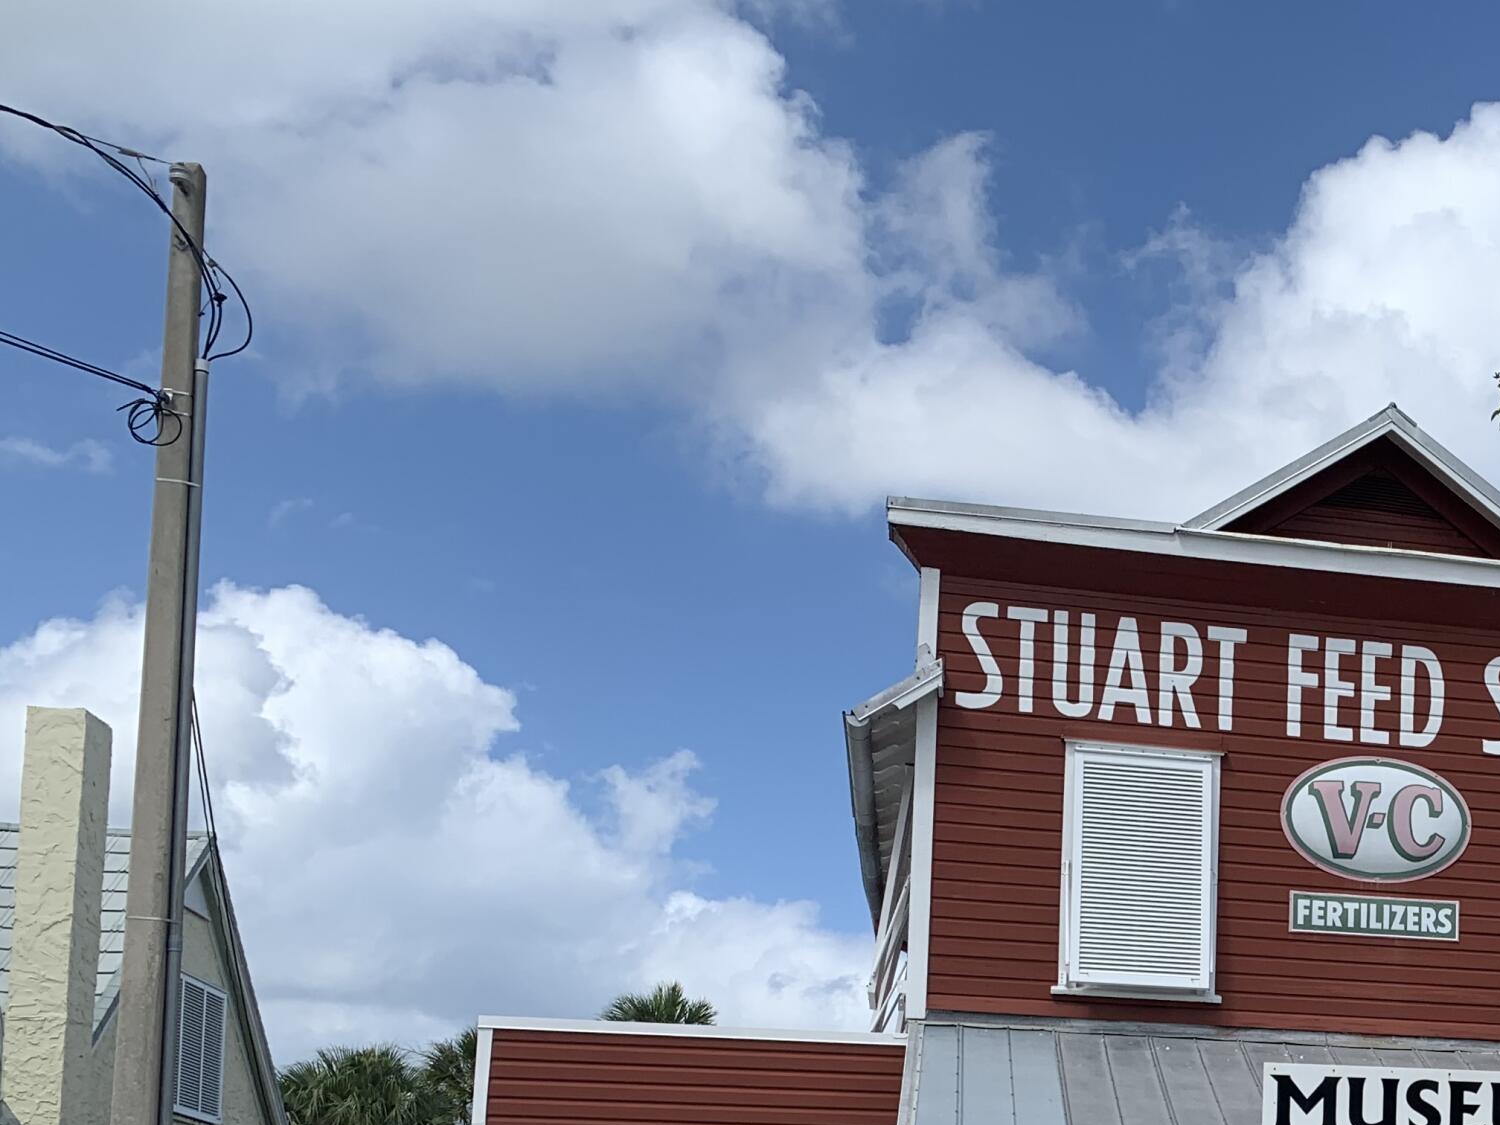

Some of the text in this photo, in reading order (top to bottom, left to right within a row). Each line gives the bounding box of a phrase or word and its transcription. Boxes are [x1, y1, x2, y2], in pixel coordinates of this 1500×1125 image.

[955, 601, 1247, 731] STUART
[1286, 633, 1444, 747] FEED
[1308, 780, 1445, 862] V-C
[1296, 899, 1454, 934] FERTILIZERS
